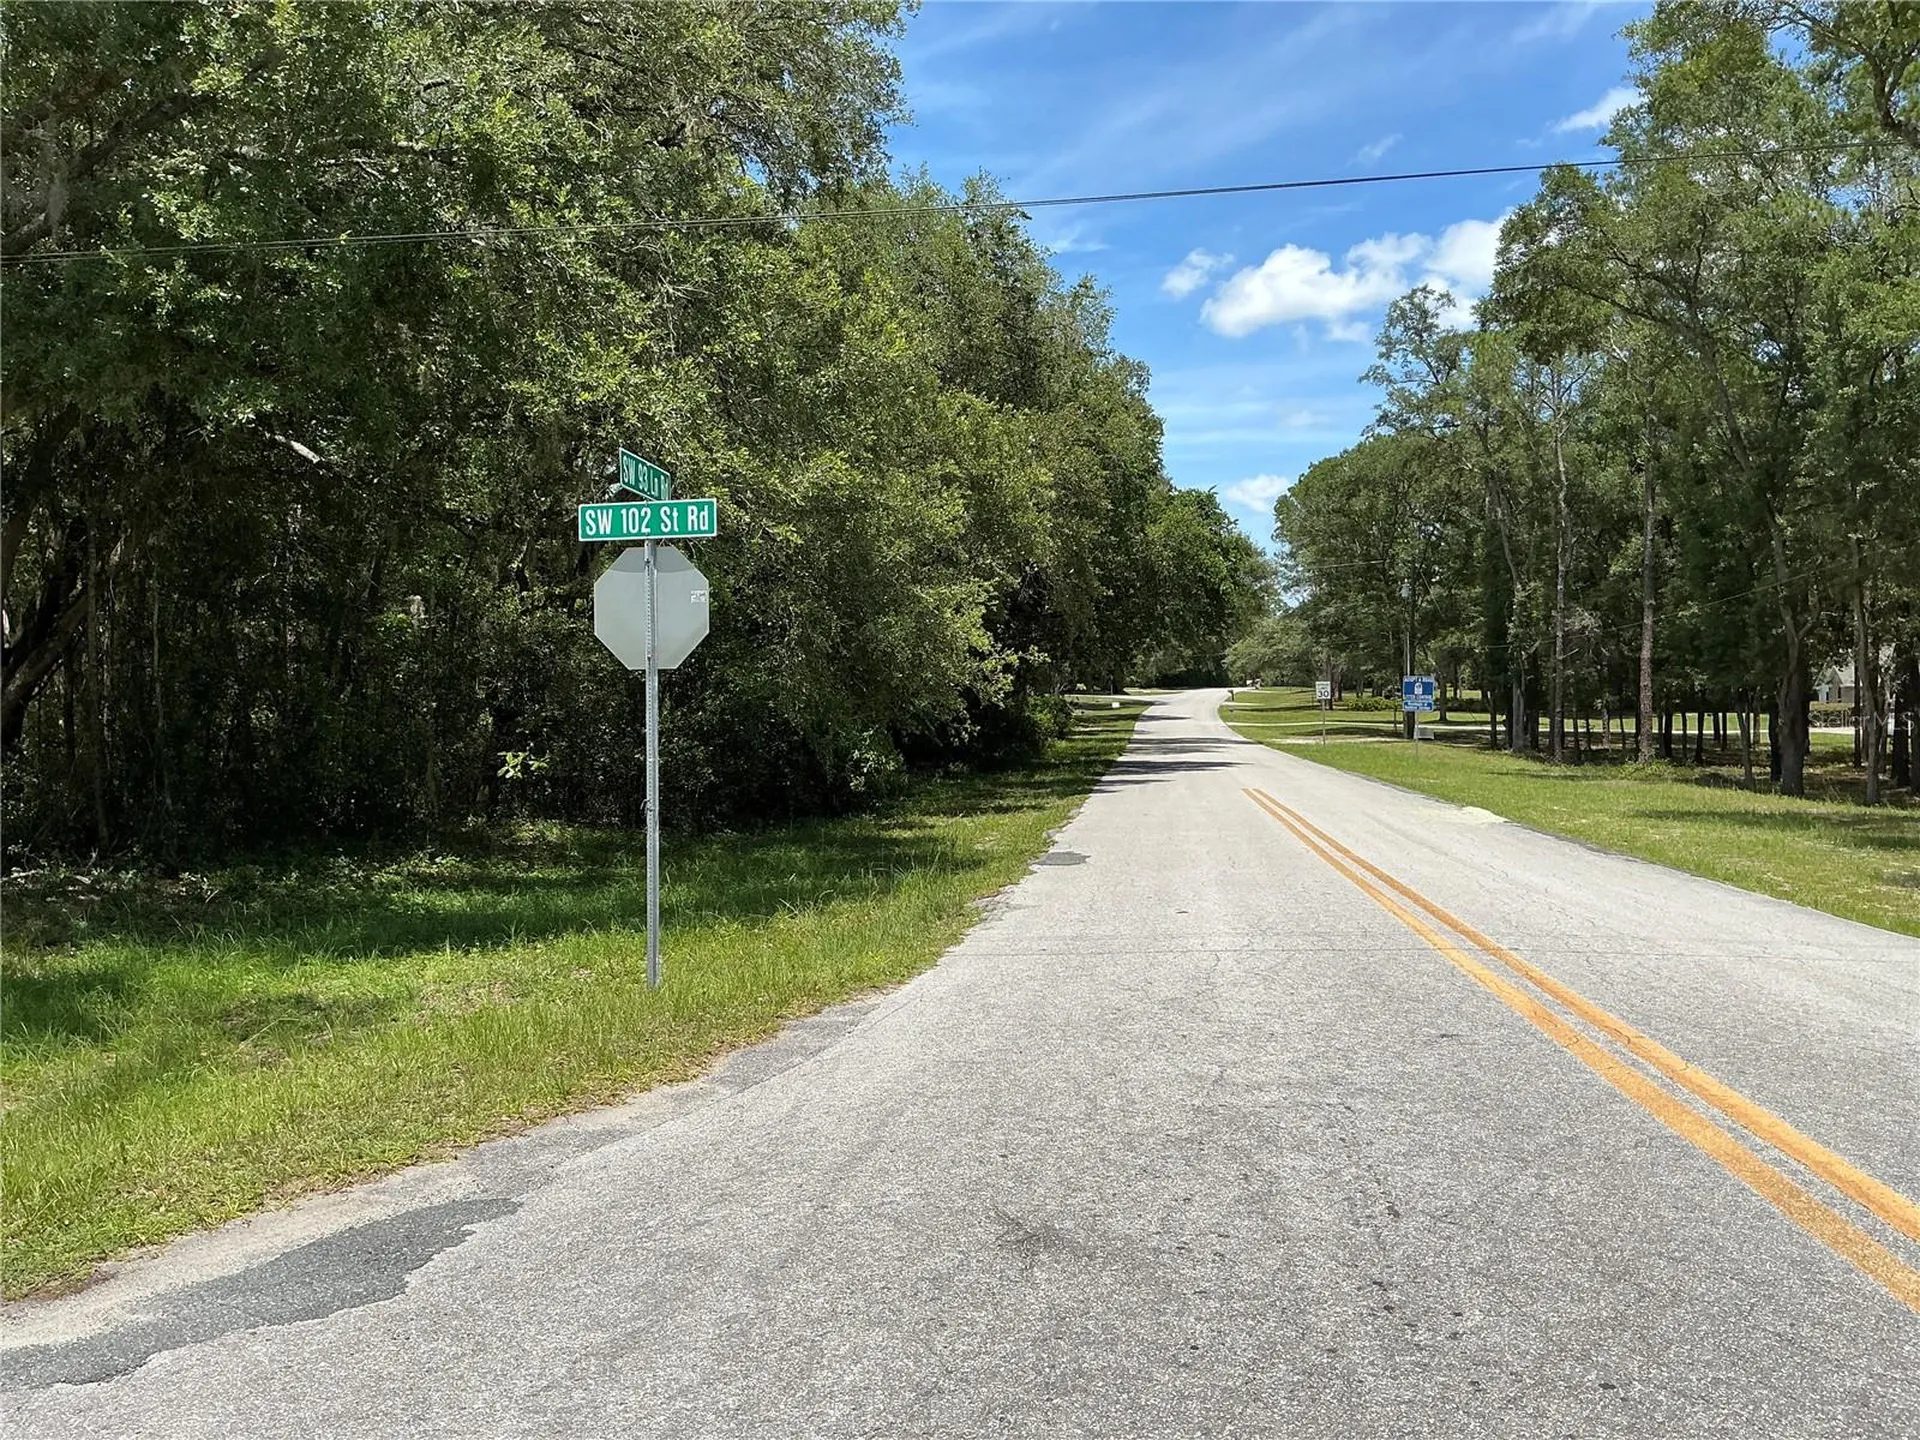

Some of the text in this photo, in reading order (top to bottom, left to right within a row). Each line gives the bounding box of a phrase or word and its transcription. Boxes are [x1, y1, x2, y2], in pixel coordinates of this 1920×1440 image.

[622, 455, 636, 485] SW
[638, 462, 649, 492] 93
[585, 504, 709, 536] SW 102 St Rd
[1318, 690, 1329, 698] 30
